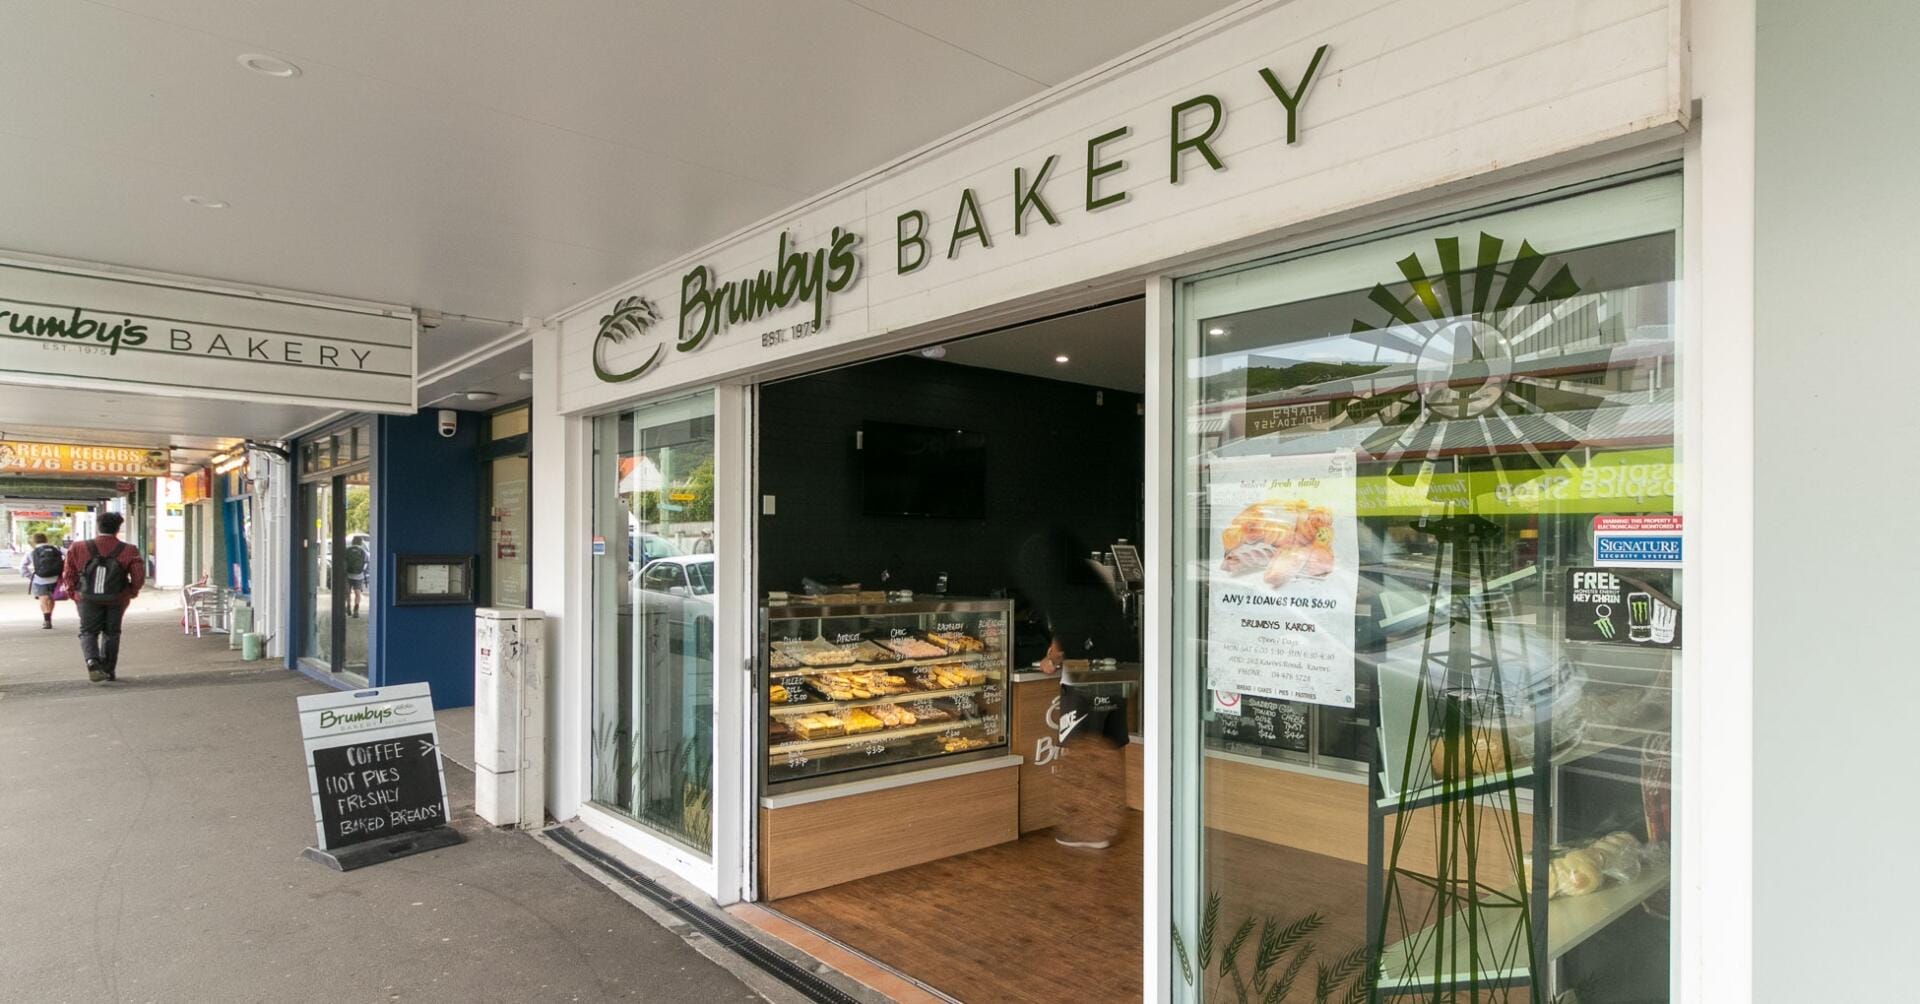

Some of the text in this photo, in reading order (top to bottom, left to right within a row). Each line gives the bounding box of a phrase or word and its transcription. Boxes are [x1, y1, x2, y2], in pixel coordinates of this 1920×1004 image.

[676, 44, 1329, 352] Brumby's BAKERY
[762, 329, 786, 347] EST.
[42, 343, 108, 356] EST. 1975
[170, 328, 371, 370] BAKERY
[17, 443, 140, 462] REAL KEBABS
[72, 460, 142, 473] 8600
[1270, 478, 1292, 489] fresh
[1298, 477, 1320, 489] daily
[1600, 538, 1679, 553] SIGNATURE
[1573, 571, 1620, 589] FREE
[1222, 594, 1337, 609] ANY 2 LOAVES FOR $6.90
[1573, 593, 1620, 603] KEY CHAIN
[1241, 618, 1316, 633] BRUMBYS KARORI
[1257, 686, 1273, 694] CAKES
[1278, 689, 1289, 697] PIES
[1295, 691, 1317, 700] PASTRIES
[346, 743, 404, 767] COFFEE
[326, 767, 400, 794] HOT PIES
[338, 787, 399, 815] FRESHLY
[340, 802, 441, 836] BAKED BREADS!
